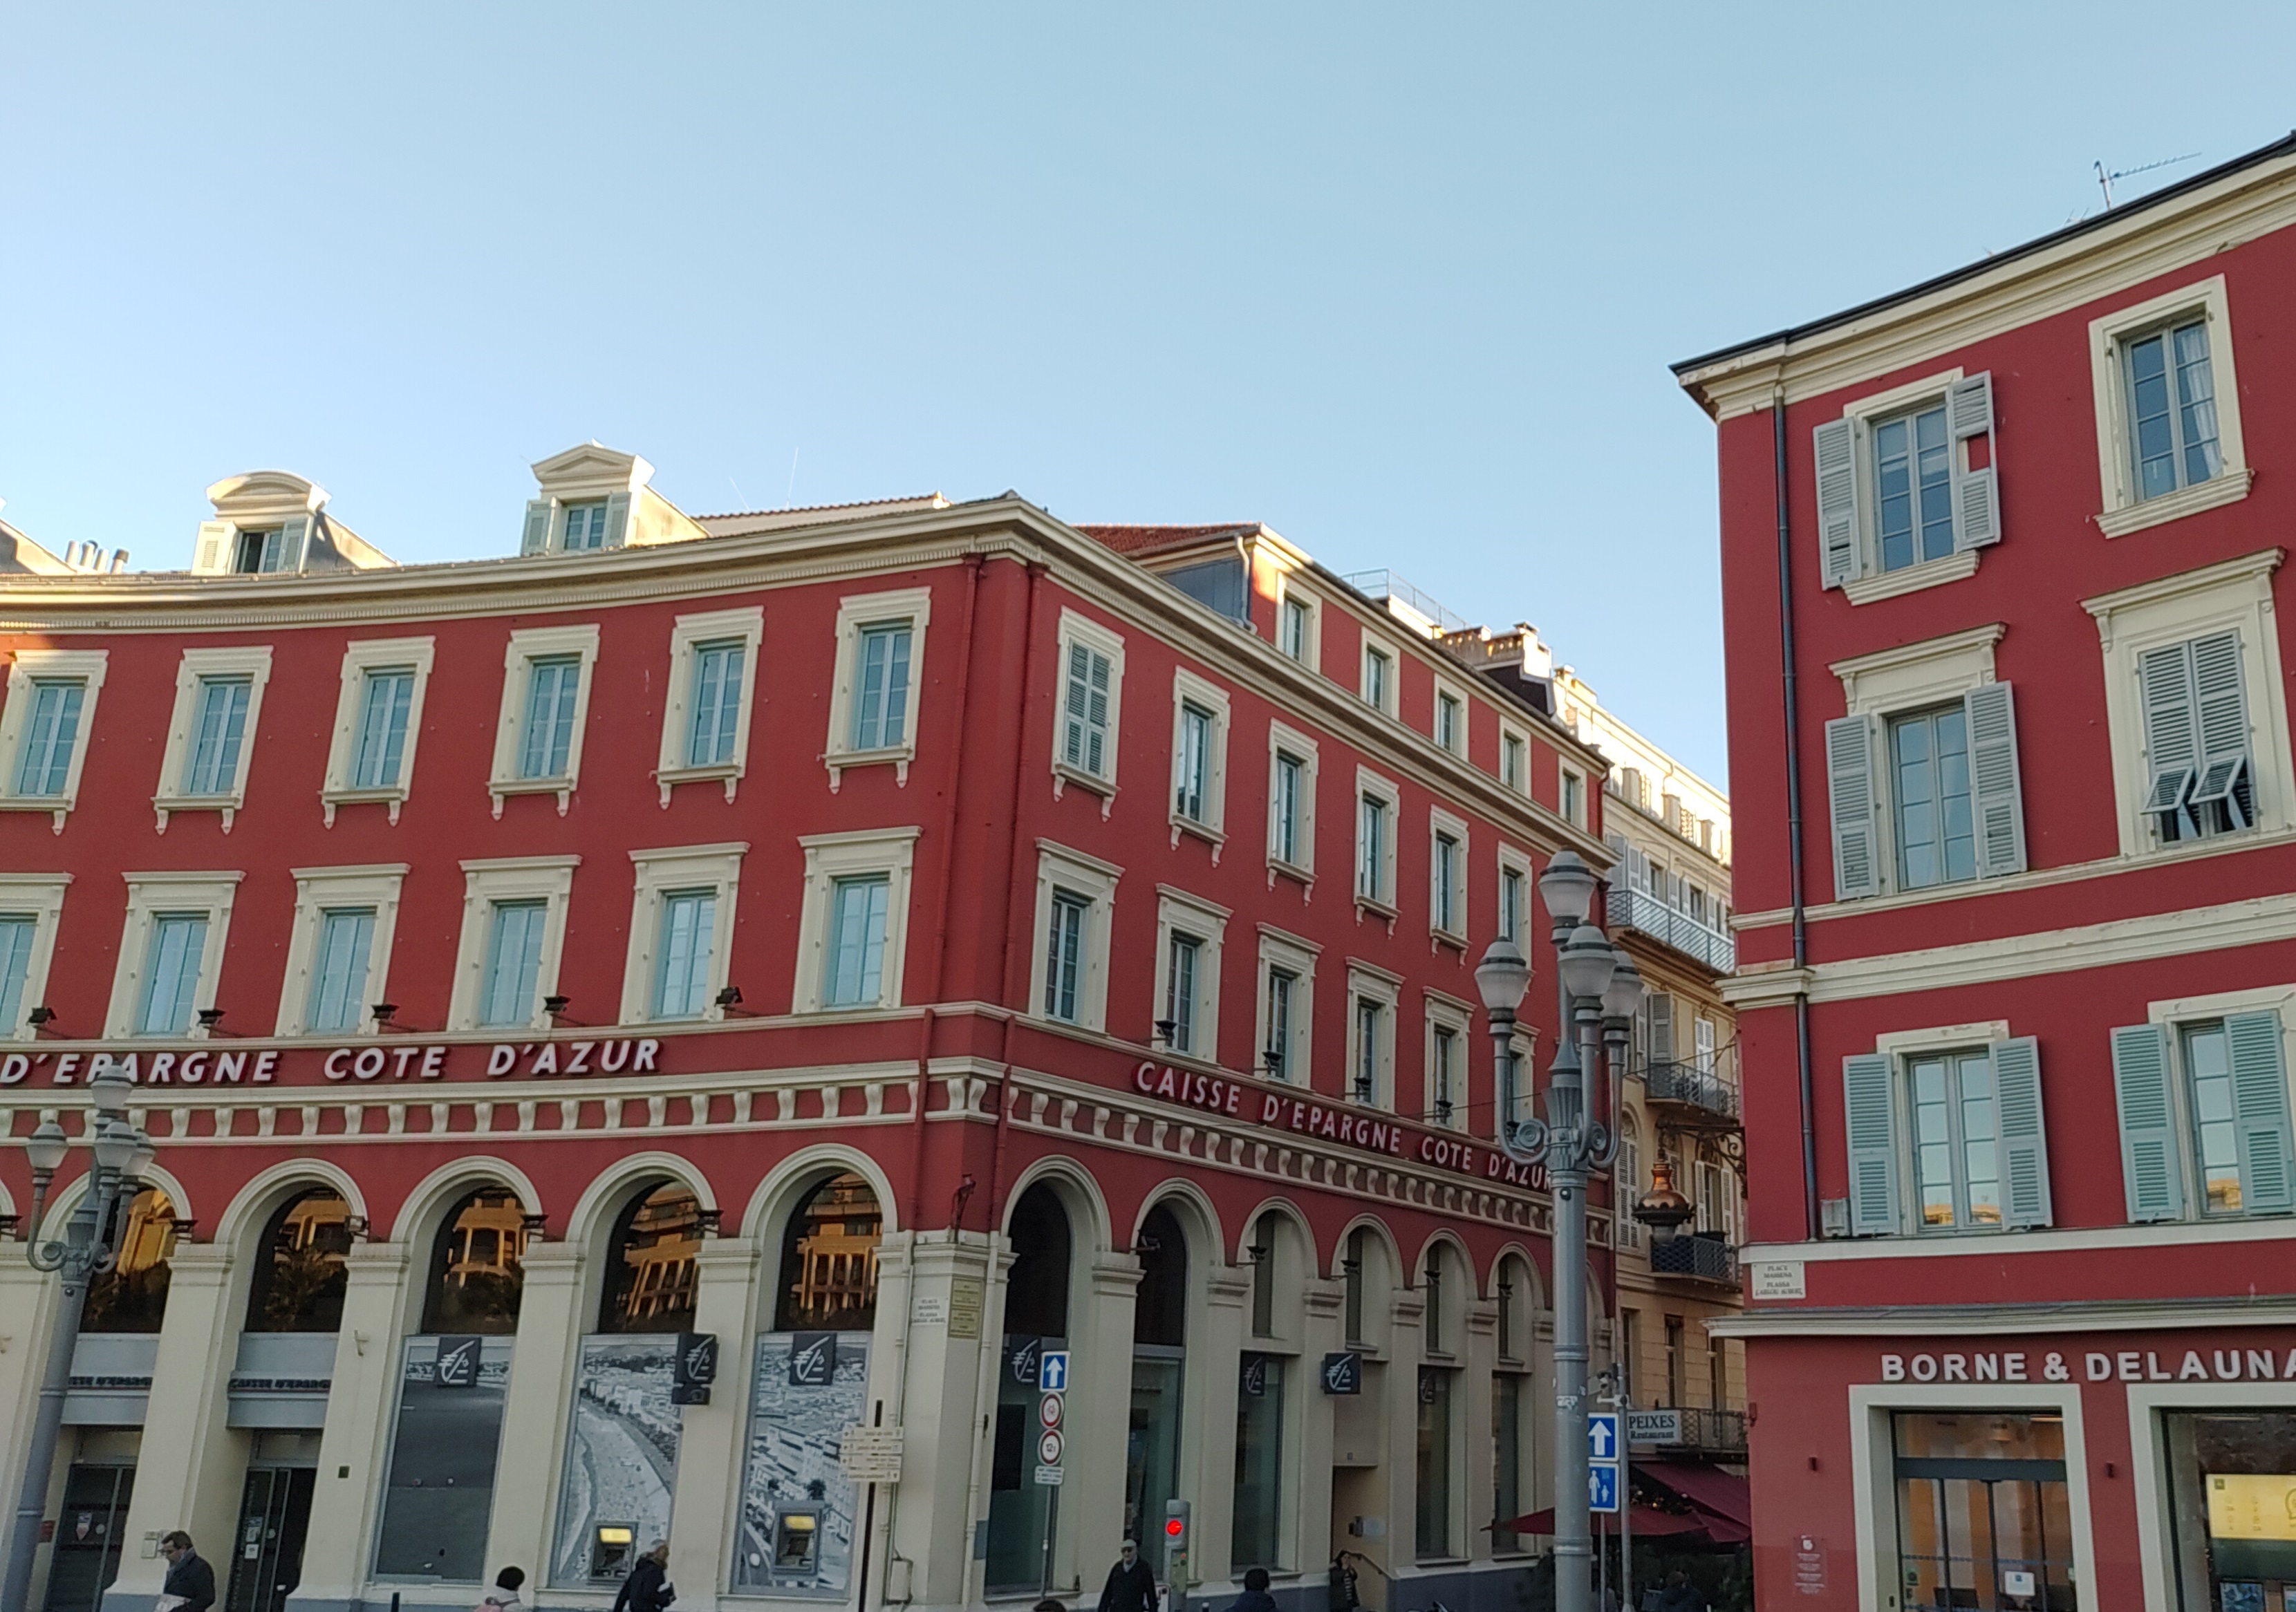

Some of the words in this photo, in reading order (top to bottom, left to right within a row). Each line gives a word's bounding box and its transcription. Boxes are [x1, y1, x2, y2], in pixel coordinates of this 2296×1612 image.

[1, 1051, 277, 1083] D'EPARGNE
[324, 1047, 446, 1080] COTE
[487, 1039, 659, 1076] D'AZUR
[1137, 1062, 1242, 1113] CAISSE
[1263, 1095, 1402, 1152] D'EPARGNE
[1421, 1136, 1473, 1170] COTE
[1880, 1353, 2026, 1381] BORNE
[2043, 1352, 2071, 1381] &
[1628, 1414, 1675, 1429] PEIXES
